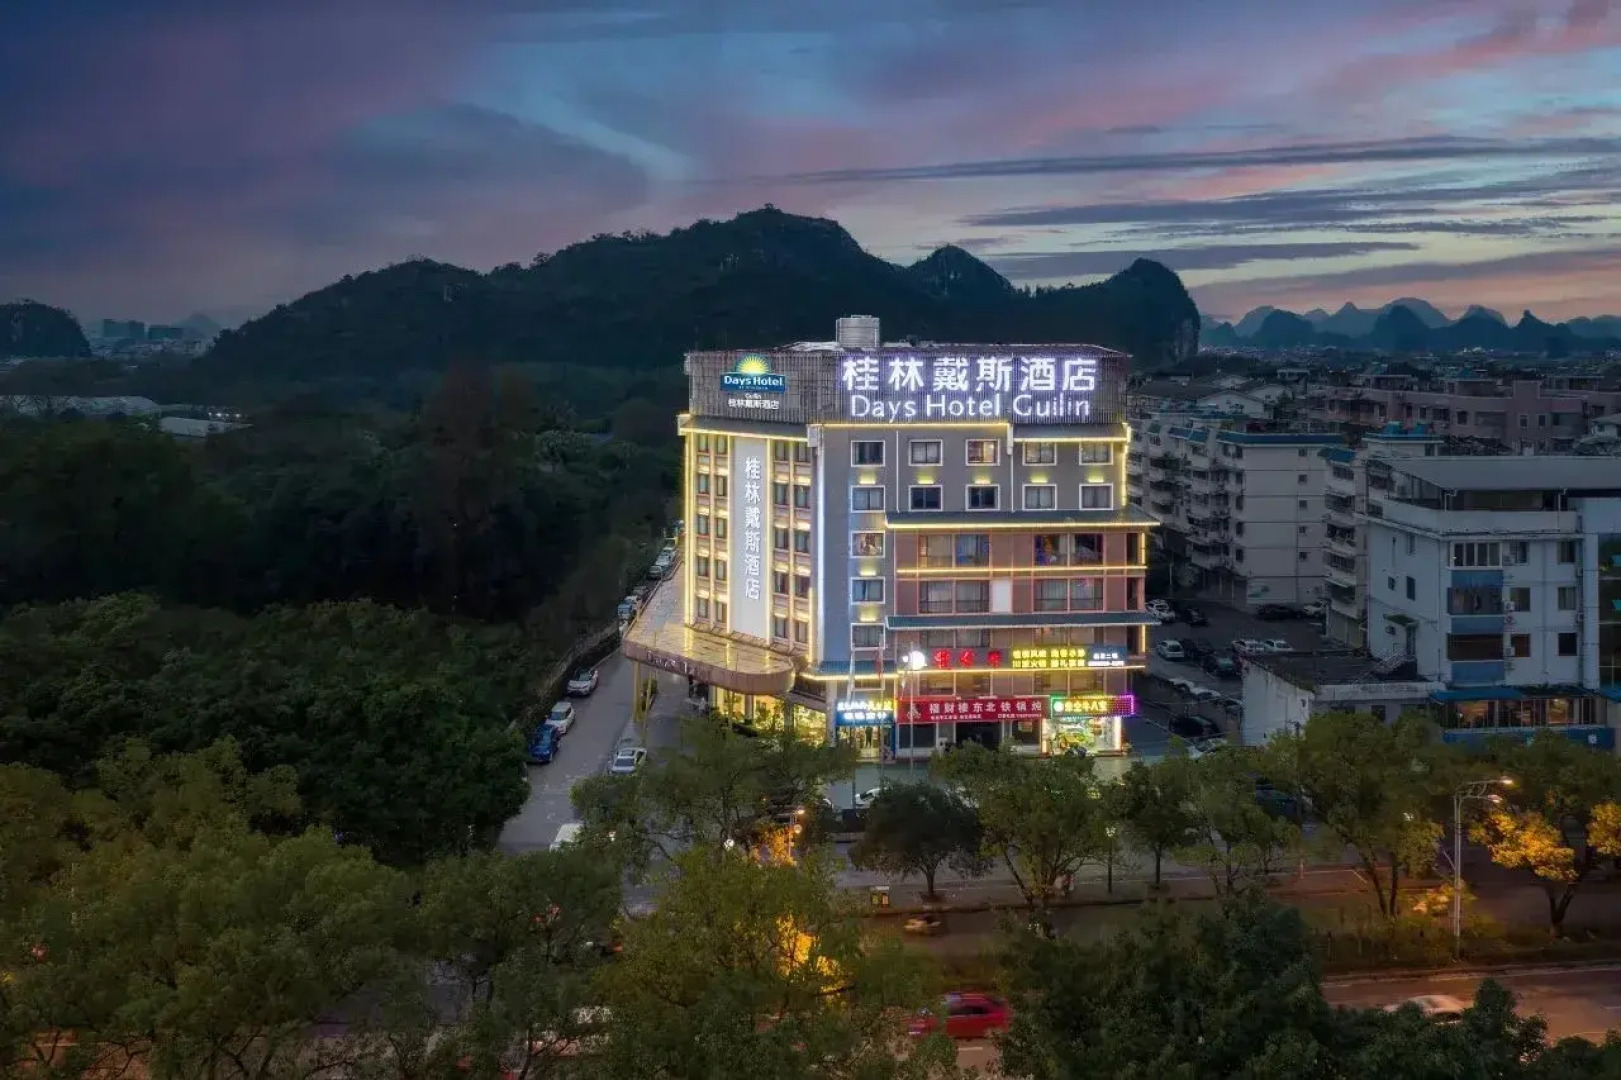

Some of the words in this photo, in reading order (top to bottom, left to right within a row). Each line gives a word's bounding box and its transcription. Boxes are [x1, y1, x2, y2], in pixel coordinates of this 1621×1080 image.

[724, 375, 752, 386] Days
[753, 376, 783, 386] Hotel
[842, 356, 1097, 392] 桂林戴斯酒店
[850, 395, 917, 423] Days
[926, 394, 1000, 417] Hotel
[1012, 393, 1090, 417] Guilin
[745, 456, 761, 600] 桂林戴斯酒店
